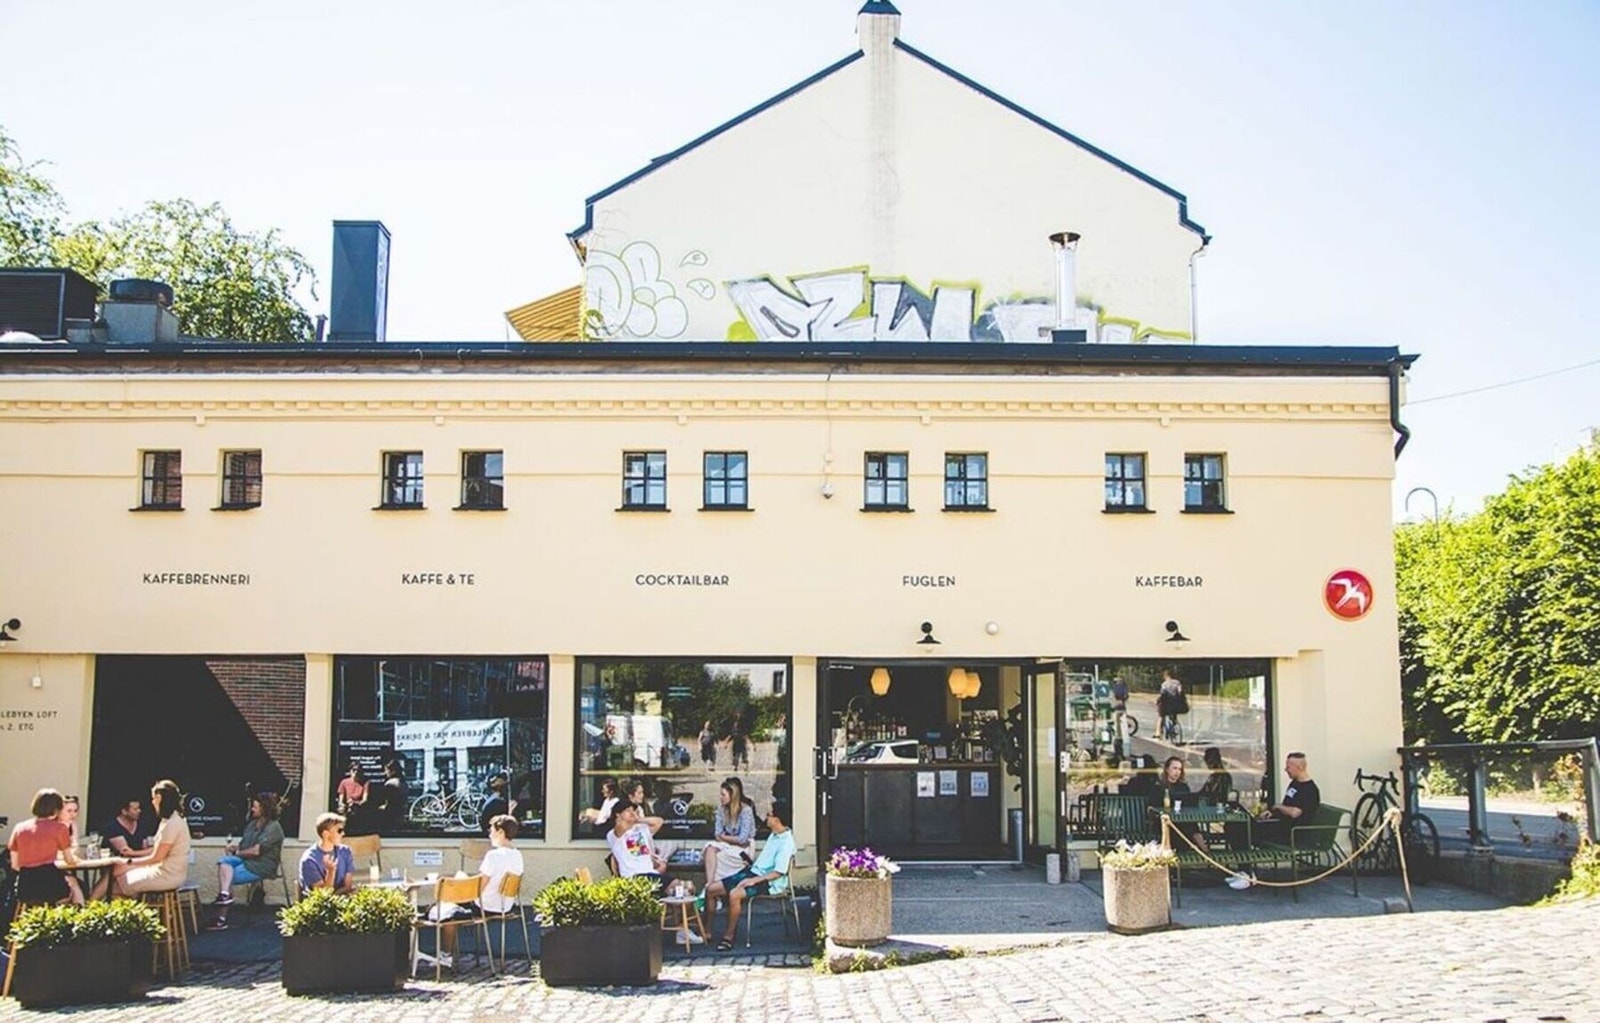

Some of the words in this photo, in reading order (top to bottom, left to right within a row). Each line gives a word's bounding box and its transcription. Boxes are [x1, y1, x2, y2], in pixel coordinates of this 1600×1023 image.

[143, 573, 250, 586] KAFFEBRENNERI
[401, 573, 443, 586] KAFFE
[446, 573, 456, 586] &
[458, 573, 475, 586] TE
[635, 574, 730, 587] COCKTAILBAR
[902, 575, 956, 588] FUGLEN
[1135, 575, 1204, 588] KAFFEBAR
[36, 710, 58, 719] LOFT
